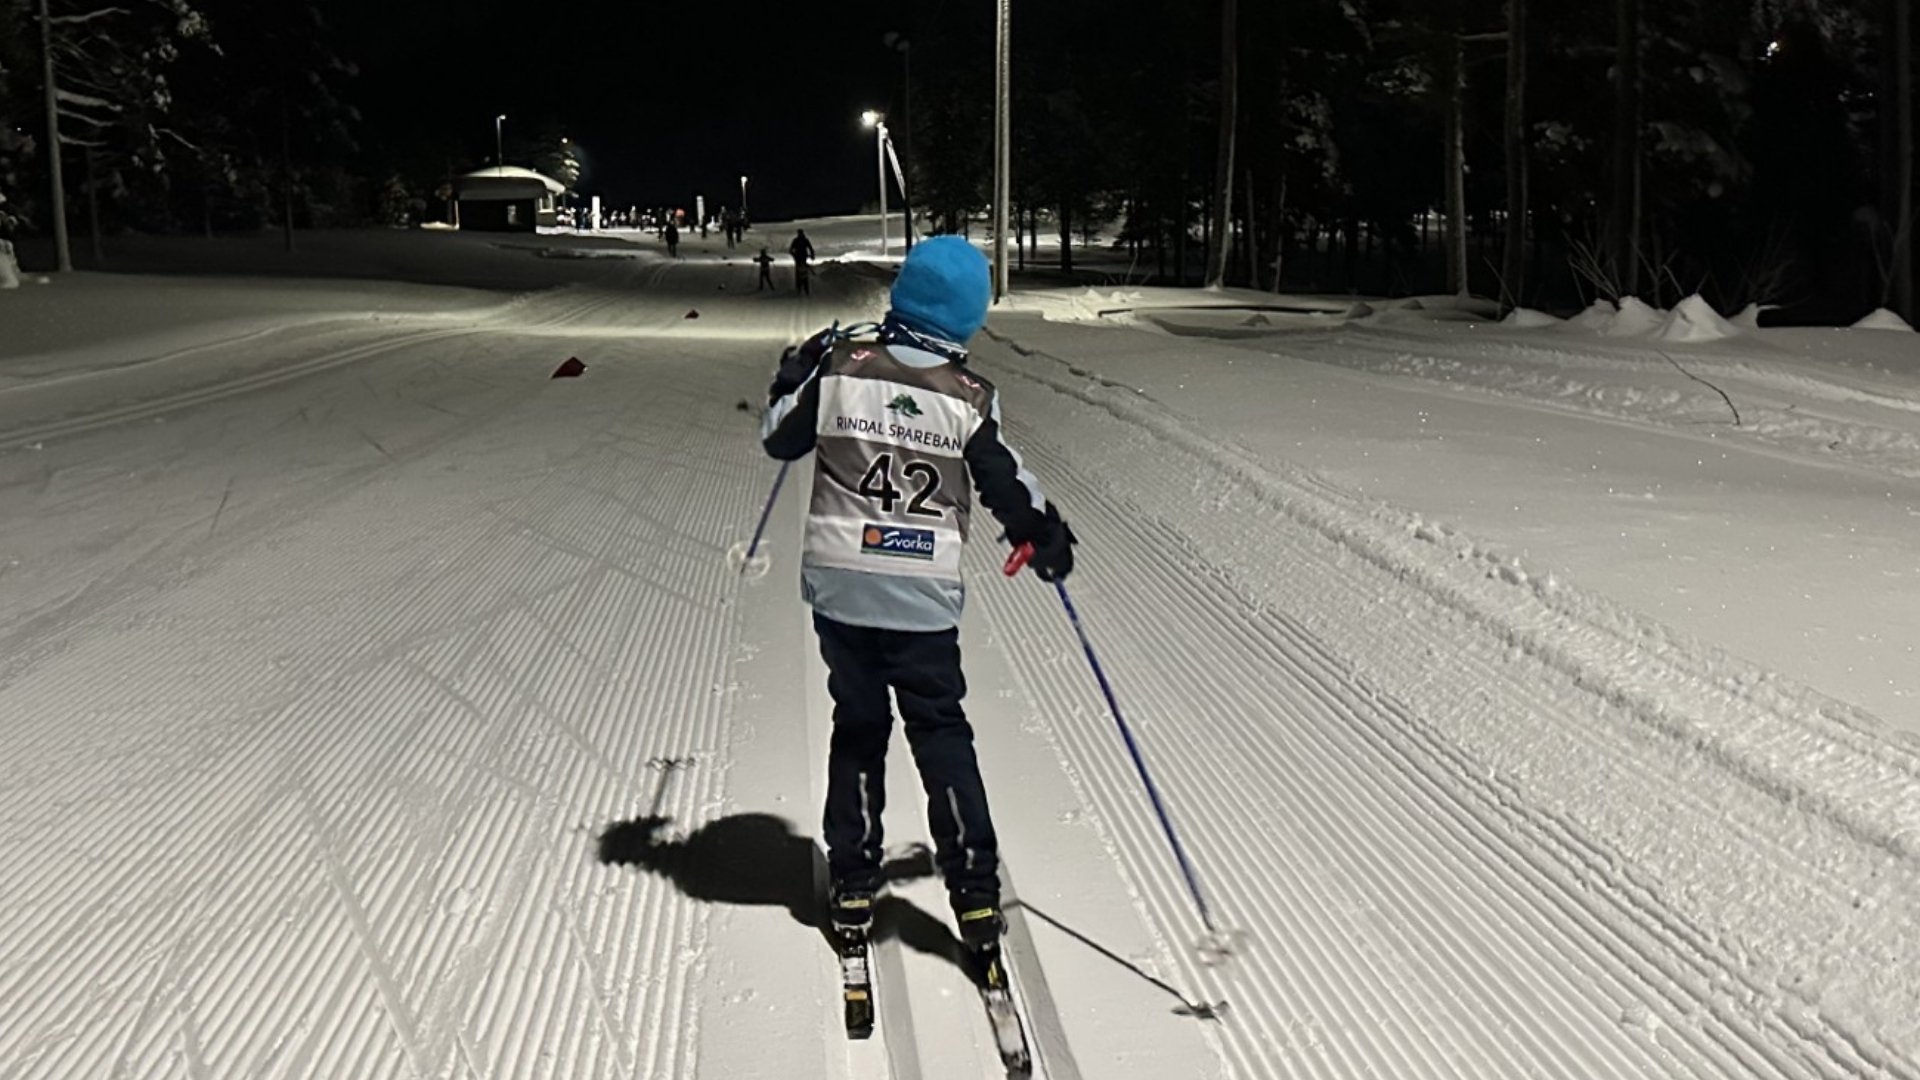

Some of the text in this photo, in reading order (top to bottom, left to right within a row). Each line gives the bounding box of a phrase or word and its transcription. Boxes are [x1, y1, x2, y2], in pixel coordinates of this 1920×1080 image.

[836, 416, 884, 435] RINDAL
[858, 453, 944, 518] 42
[883, 531, 932, 551] Svorka
